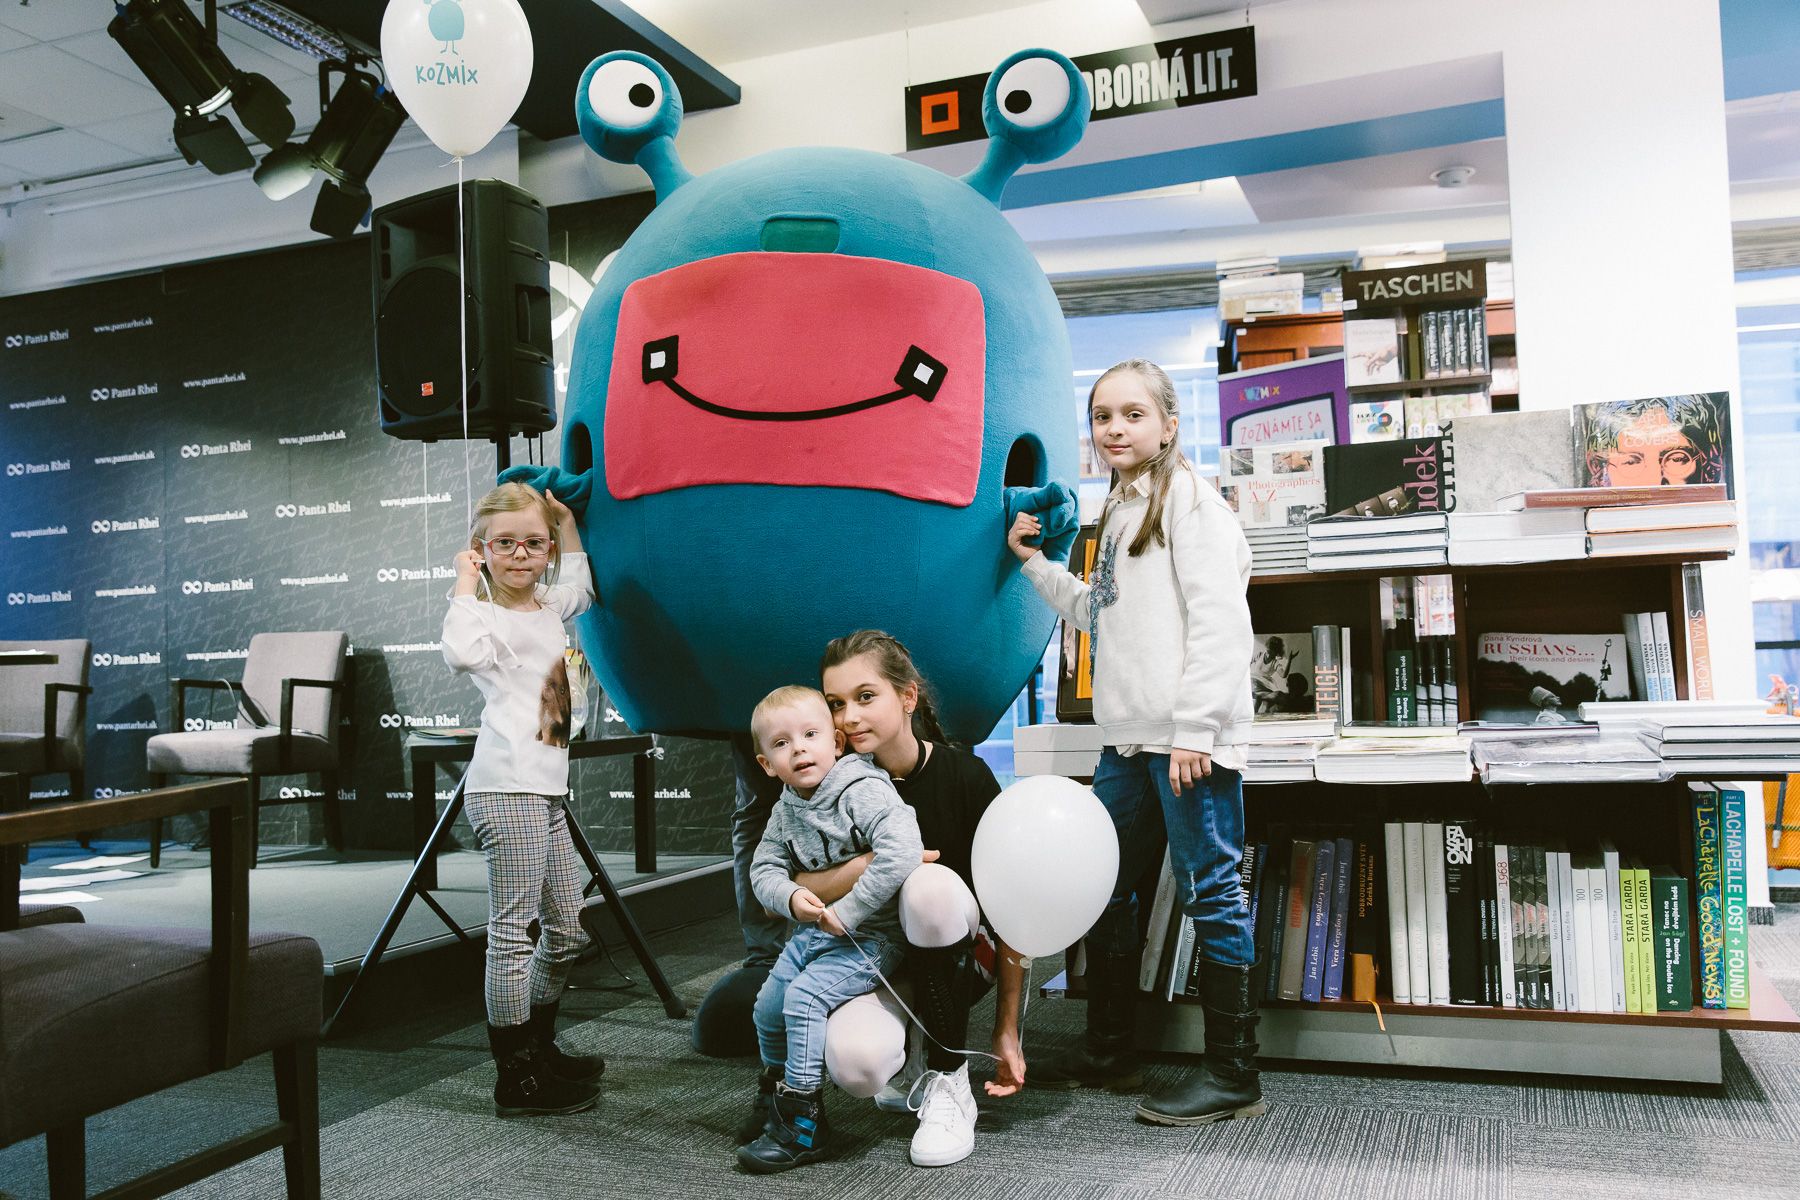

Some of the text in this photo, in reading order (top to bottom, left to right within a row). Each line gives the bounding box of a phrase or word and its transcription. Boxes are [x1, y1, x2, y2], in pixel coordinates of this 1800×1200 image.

[1193, 47, 1238, 95] LIT.
[1359, 269, 1473, 301] TASCHEN
[94, 317, 153, 333] www.pantarhei.sk
[24, 329, 69, 346] Panta Rhei
[183, 372, 246, 388] www.pantarhei.sk
[111, 382, 158, 399] Panta Rhei
[9, 395, 67, 411] www.pantarhei.sk
[278, 430, 346, 446] www.pantarhei.sk
[202, 440, 251, 457] Panta Rhei
[94, 450, 155, 466] www.pantarhei.sk
[25, 459, 71, 475] Panta Rhei
[1248, 477, 1321, 490] Photographers
[380, 492, 452, 508] www.pantarhei.sk
[184, 509, 248, 525] www.pantarhei.sk
[299, 501, 351, 517] Panta Rhei
[111, 516, 160, 532] Panta Rhei
[11, 525, 68, 540] www.pantarhei.sk
[280, 572, 349, 587] www.pantarhei.sk
[401, 565, 457, 581] Panta Rhei
[95, 584, 157, 598] www.pantarhei.sk
[203, 578, 254, 593] Panta Rhei
[27, 590, 72, 603] Panta Rhei
[383, 641, 442, 655] www.pantarhei
[1689, 609, 1710, 700] SMALL WORL
[112, 651, 161, 666] Panta Rhei
[1315, 664, 1339, 712] TEIGE
[97, 721, 158, 732] www.pantarhei.sk
[404, 714, 460, 727] Panta Rhei
[609, 788, 691, 799] www.arhei.sk
[1446, 825, 1464, 839] FA
[1446, 838, 1473, 852] SHI
[1725, 801, 1743, 893] LACHAPELLE
[1241, 846, 1255, 884] MICHAEL
[1446, 850, 1472, 865] ON
[1497, 861, 1508, 888] 1968
[1575, 888, 1586, 901] 100
[1593, 888, 1603, 901] 100
[1624, 879, 1633, 910] GARDA
[1639, 879, 1648, 910] GARDA
[1700, 896, 1720, 947] Good
[1727, 897, 1744, 934] LOST
[1665, 947, 1673, 958] the
[1673, 938, 1681, 965] Dancing
[1703, 951, 1722, 999] News
[1728, 949, 1745, 998] FOUND
